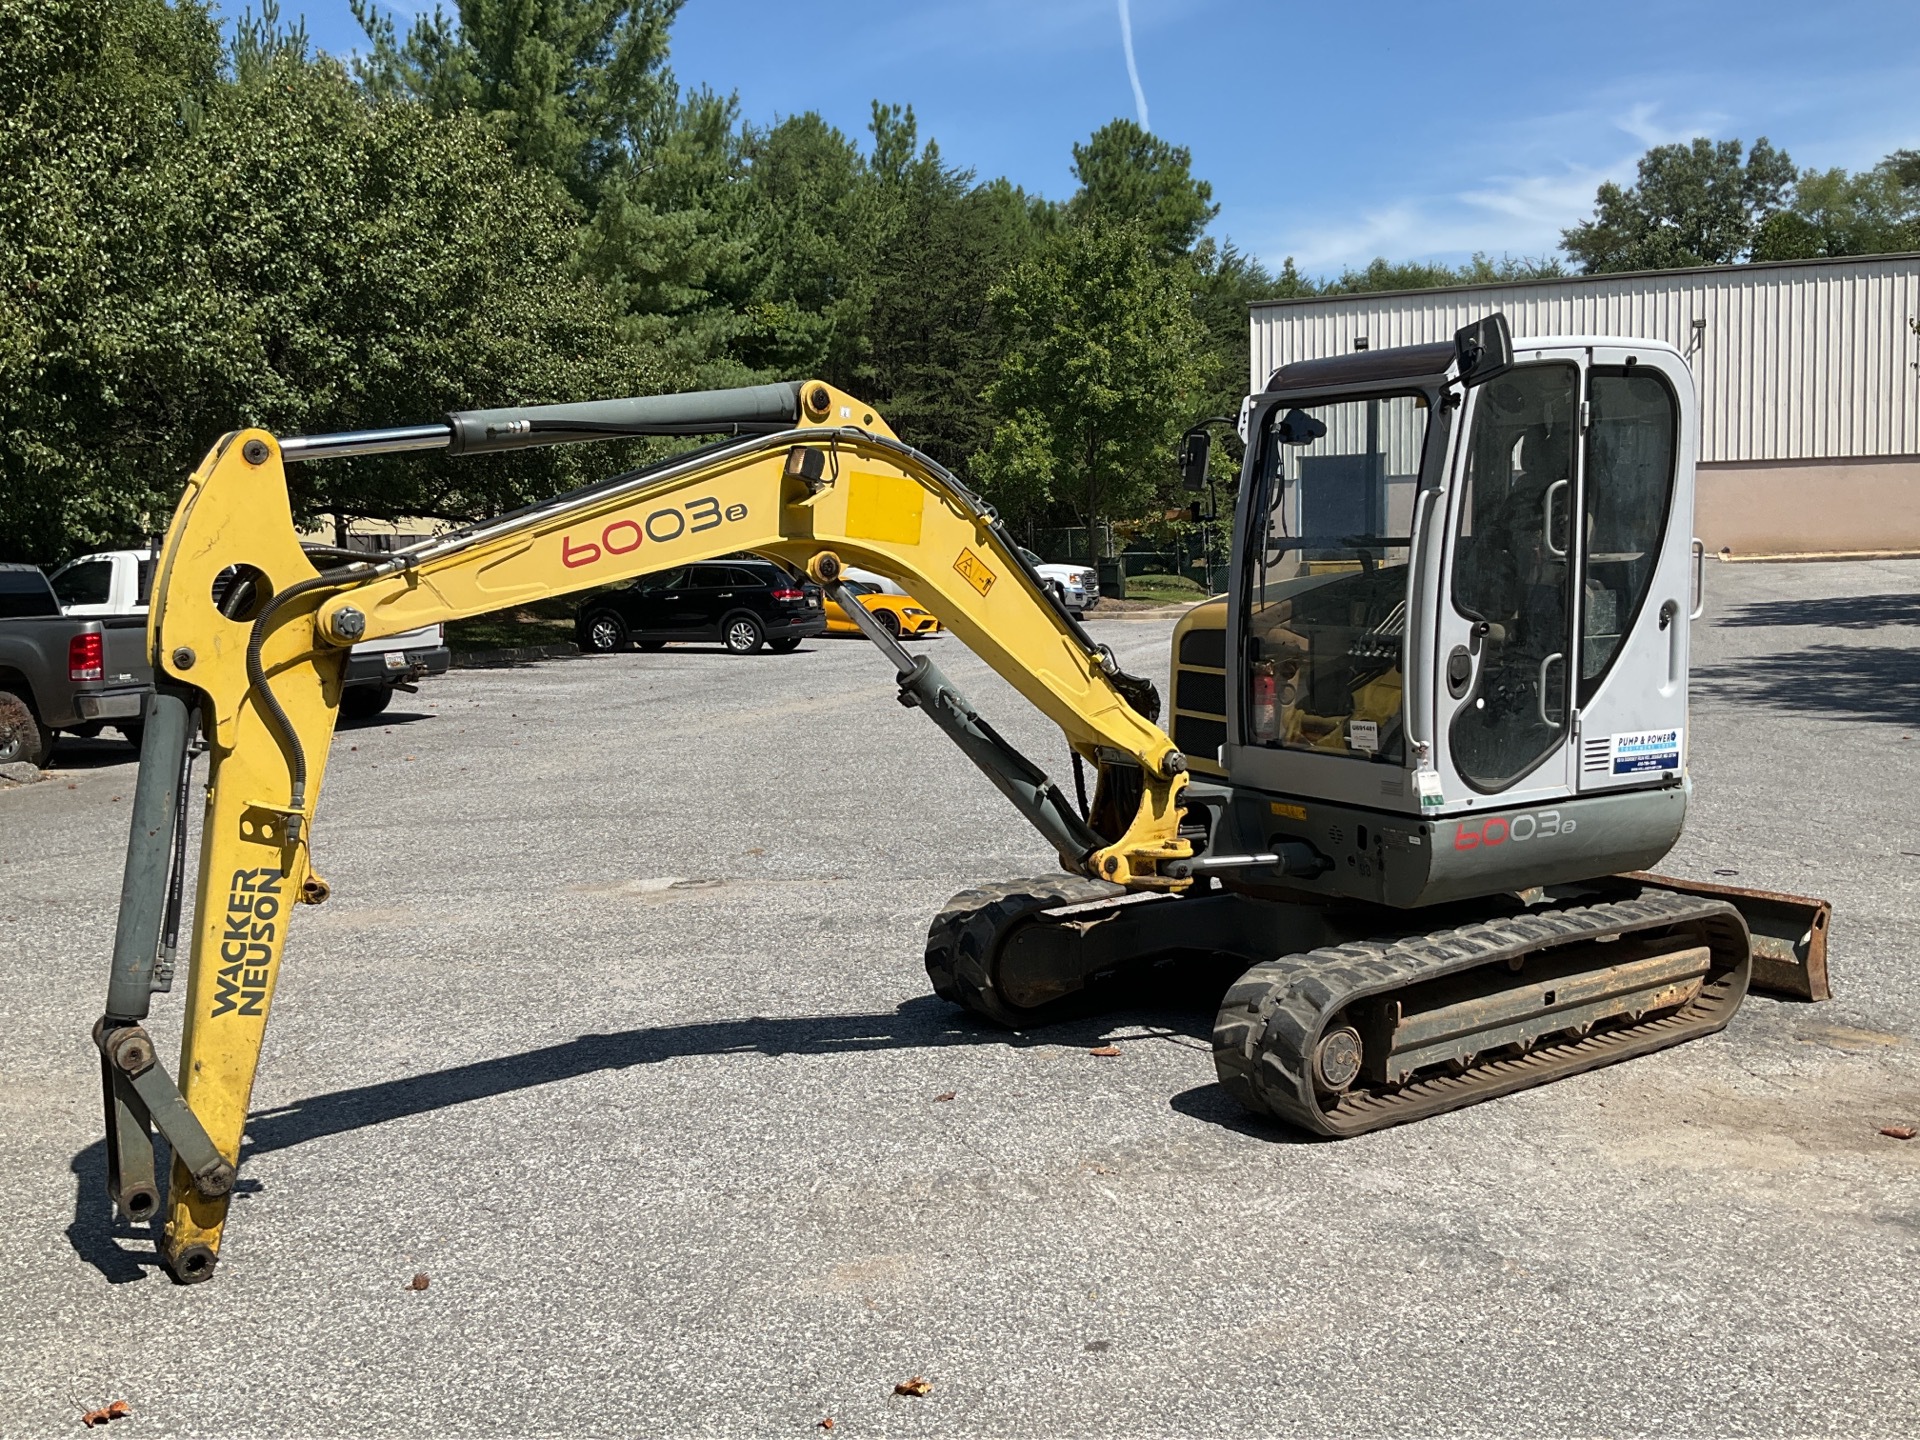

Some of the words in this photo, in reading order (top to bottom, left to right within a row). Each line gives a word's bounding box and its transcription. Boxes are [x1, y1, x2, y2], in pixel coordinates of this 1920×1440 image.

[562, 496, 722, 569] 6003
[1618, 736, 1639, 746] PUMP
[1640, 735, 1646, 745] &
[1647, 734, 1671, 744] POWER
[1454, 810, 1560, 851] 6003
[211, 867, 259, 1018] WACKER
[238, 867, 283, 1017] NEUSON
